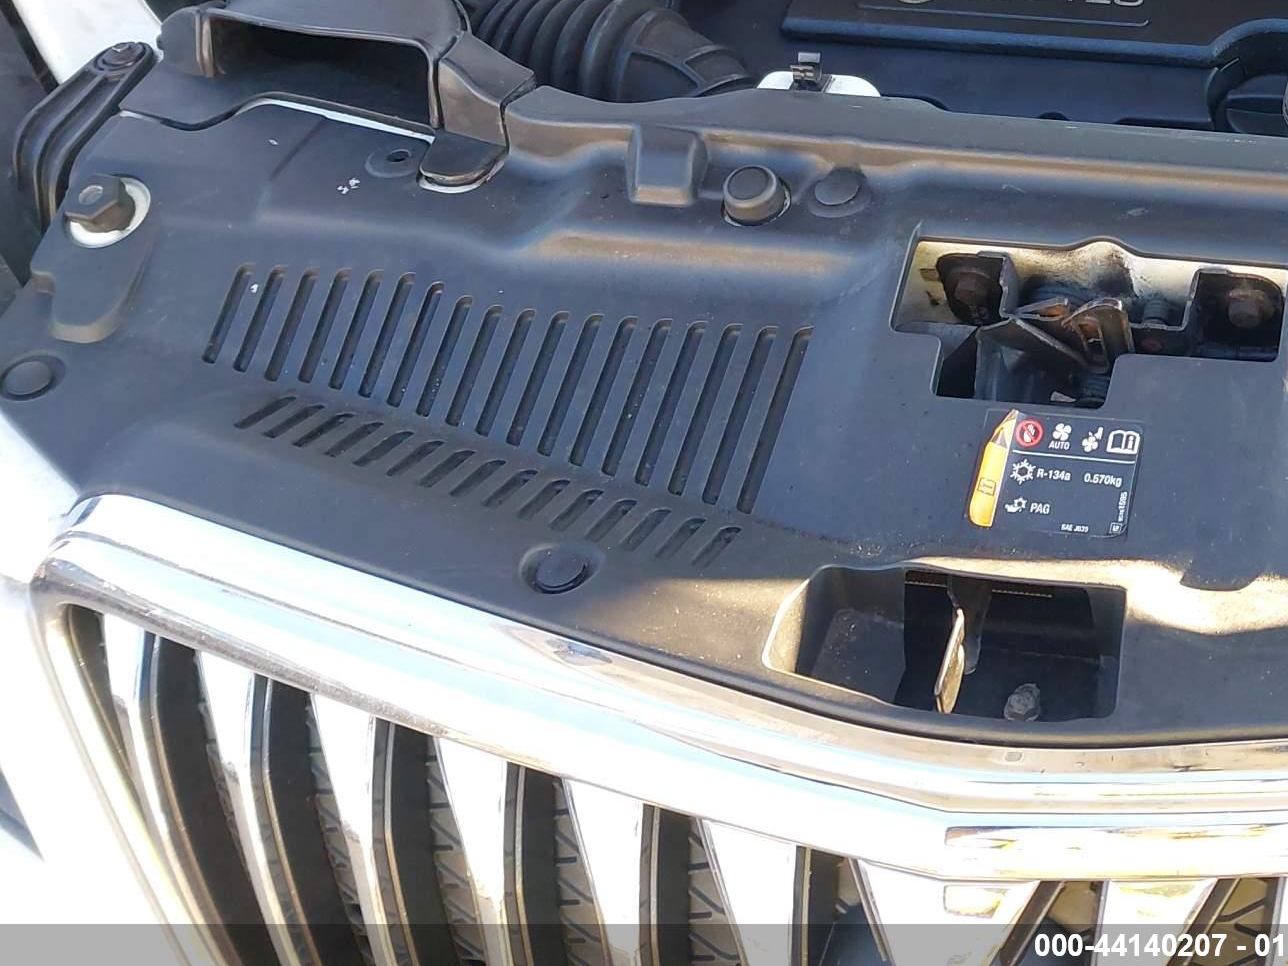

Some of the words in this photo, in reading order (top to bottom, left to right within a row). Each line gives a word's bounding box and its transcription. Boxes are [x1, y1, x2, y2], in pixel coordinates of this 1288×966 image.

[1048, 441, 1070, 450] AUTO
[1036, 469, 1071, 480] R-134a
[1084, 473, 1122, 487] 0.570kg
[1030, 503, 1050, 514] PAG
